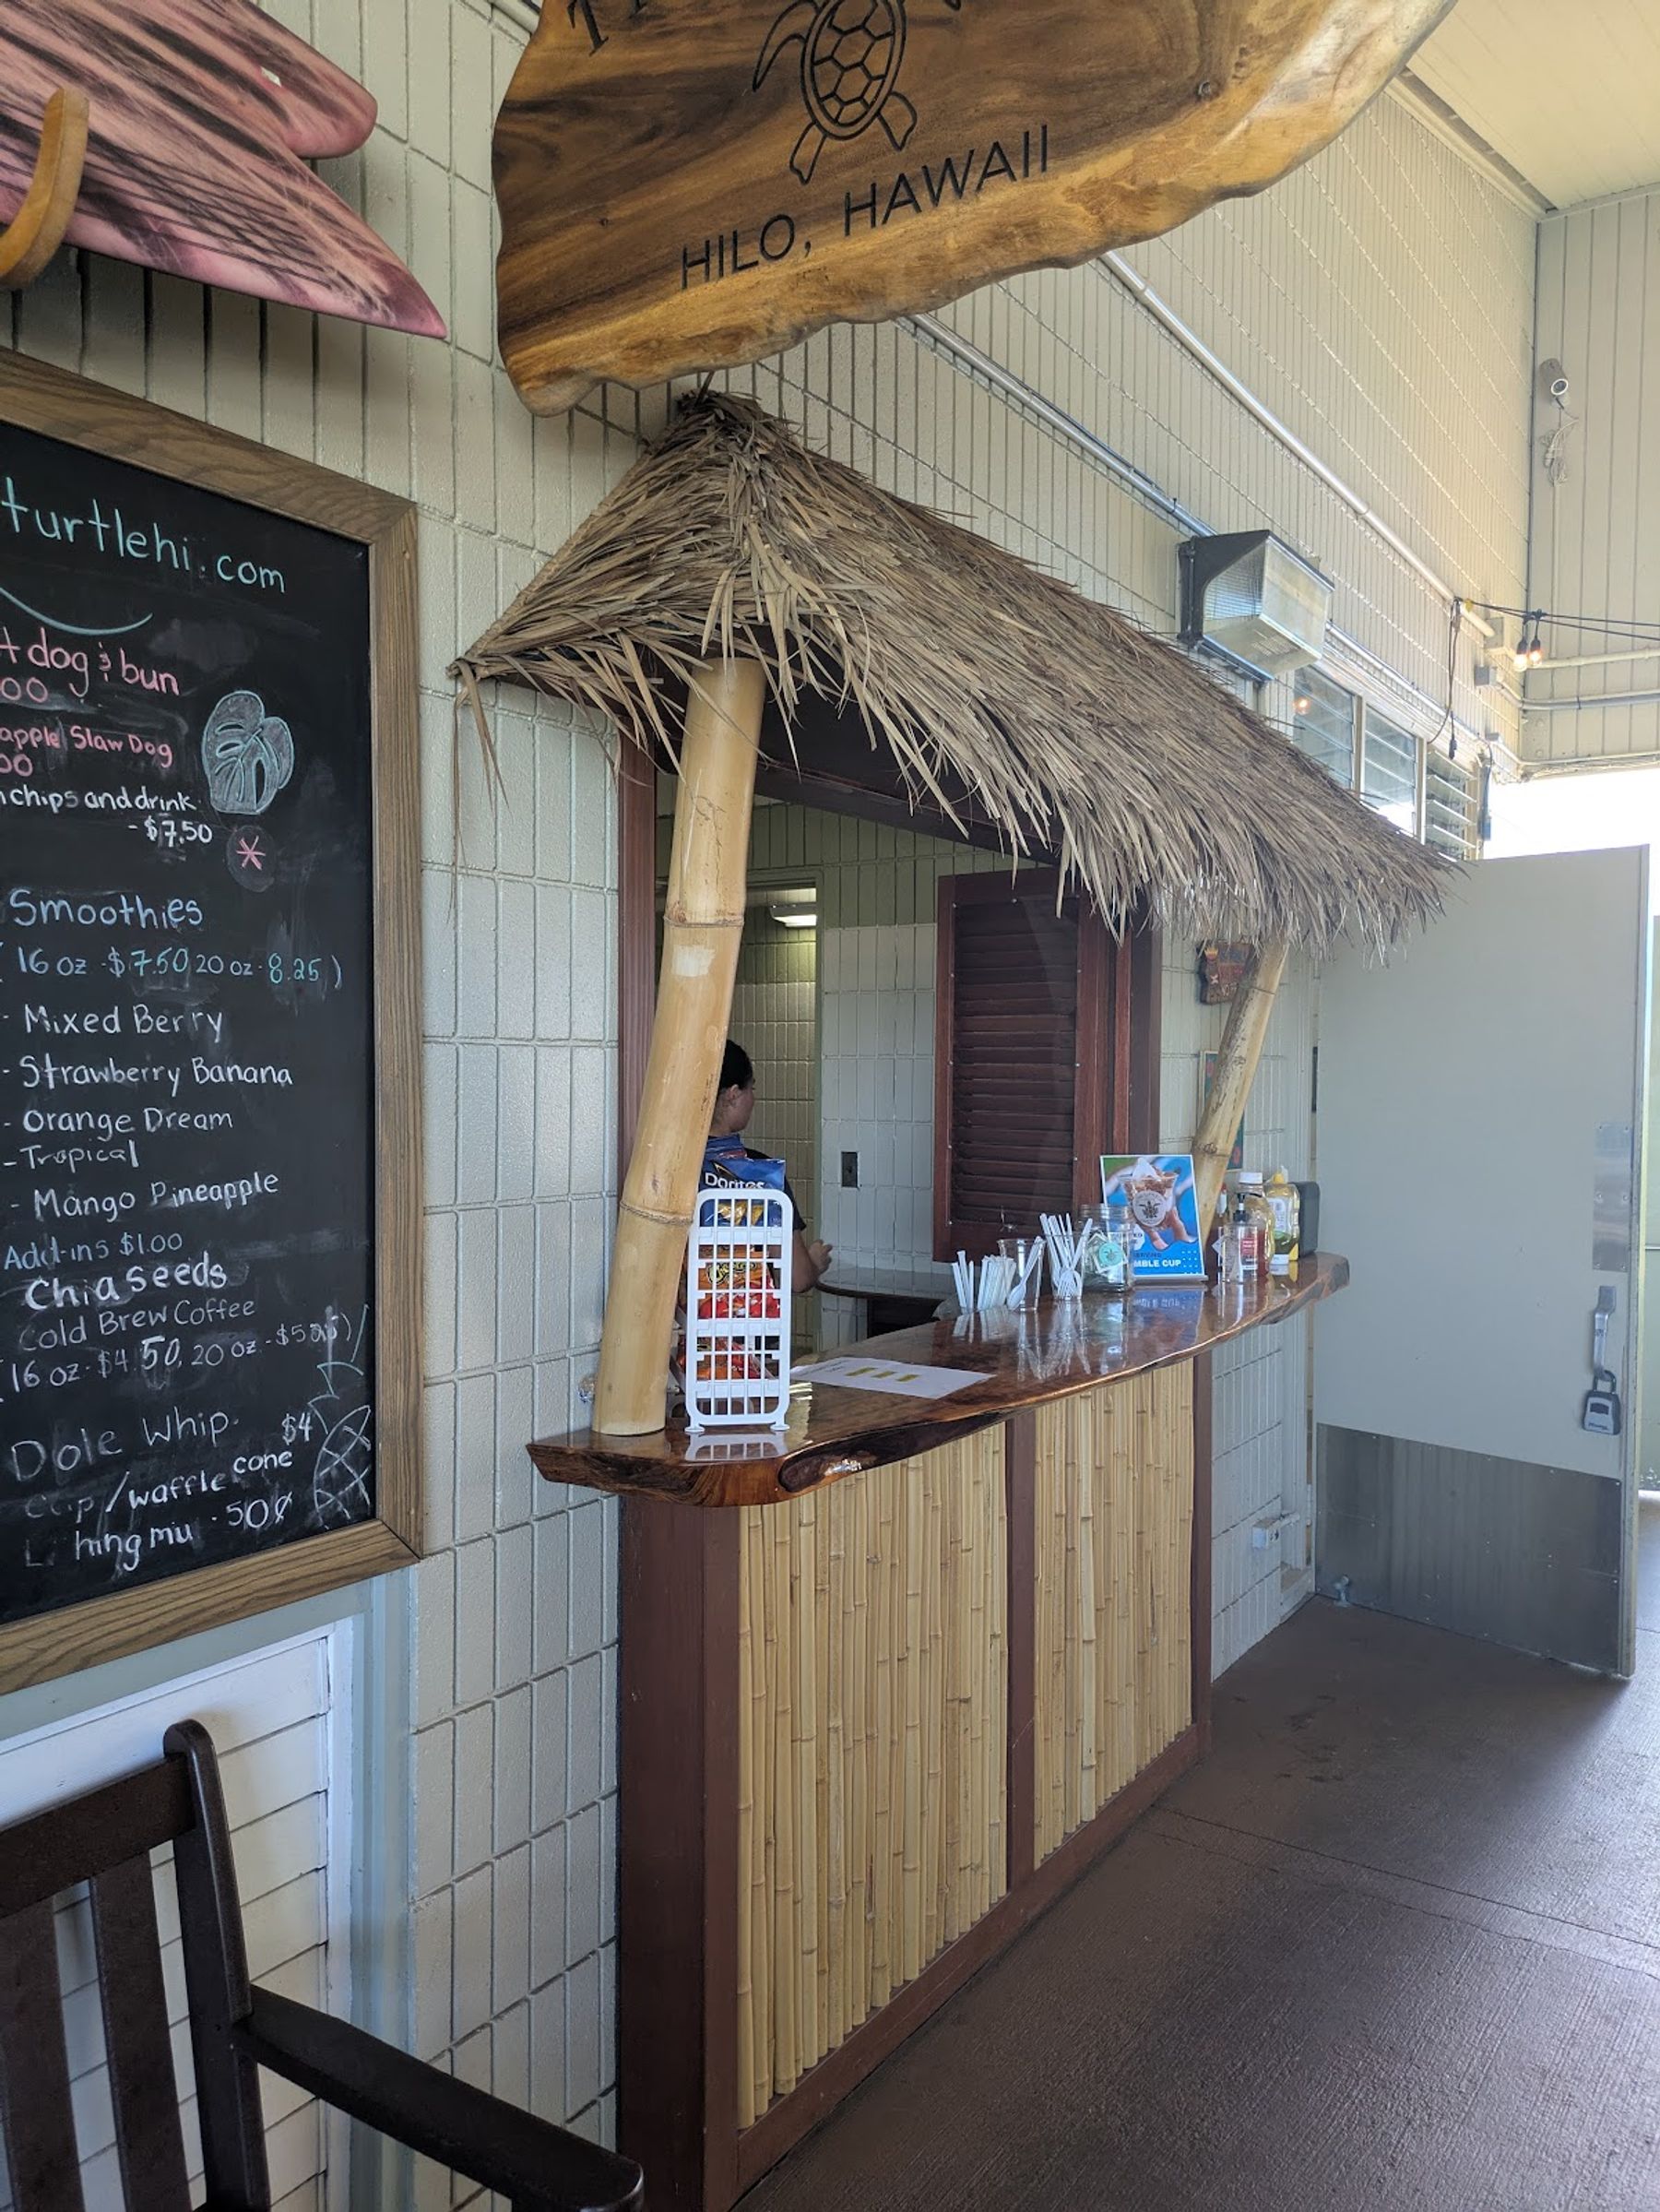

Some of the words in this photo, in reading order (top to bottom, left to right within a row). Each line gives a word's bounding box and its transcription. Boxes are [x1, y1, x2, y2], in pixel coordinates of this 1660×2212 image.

[682, 213, 812, 290] HILO,
[844, 125, 1049, 236] HAWAII
[28, 627, 89, 697] dog
[120, 648, 180, 696] bun
[70, 725, 124, 753] Slaw
[128, 733, 173, 768] Dog
[10, 784, 78, 814] chips
[84, 786, 131, 810] and
[135, 786, 196, 811] drink
[9, 888, 203, 930] Smoothies
[18, 946, 49, 974] 16
[57, 956, 87, 976] oz
[196, 954, 224, 974] 20
[231, 959, 254, 976] oz
[24, 1004, 121, 1034] Mixed
[133, 1004, 222, 1043] Berry
[19, 1052, 180, 1097] Strawberry
[192, 1056, 292, 1086] Banana
[23, 1109, 136, 1142] Orange
[144, 1107, 233, 1133] Dream
[34, 1189, 136, 1222] Mango
[151, 1171, 279, 1210] Pineapple
[120, 1232, 183, 1255] $1.00
[1162, 1259, 1182, 1267] CUP
[25, 1277, 120, 1311] Chia
[99, 1305, 167, 1335] Brew
[174, 1298, 255, 1326] Coffee
[12, 1360, 40, 1393] 16
[191, 1343, 224, 1366] 20
[231, 1340, 256, 1358] oz
[11, 1428, 122, 1481] Dole
[281, 1412, 314, 1445] $4
[232, 1450, 293, 1474] cone
